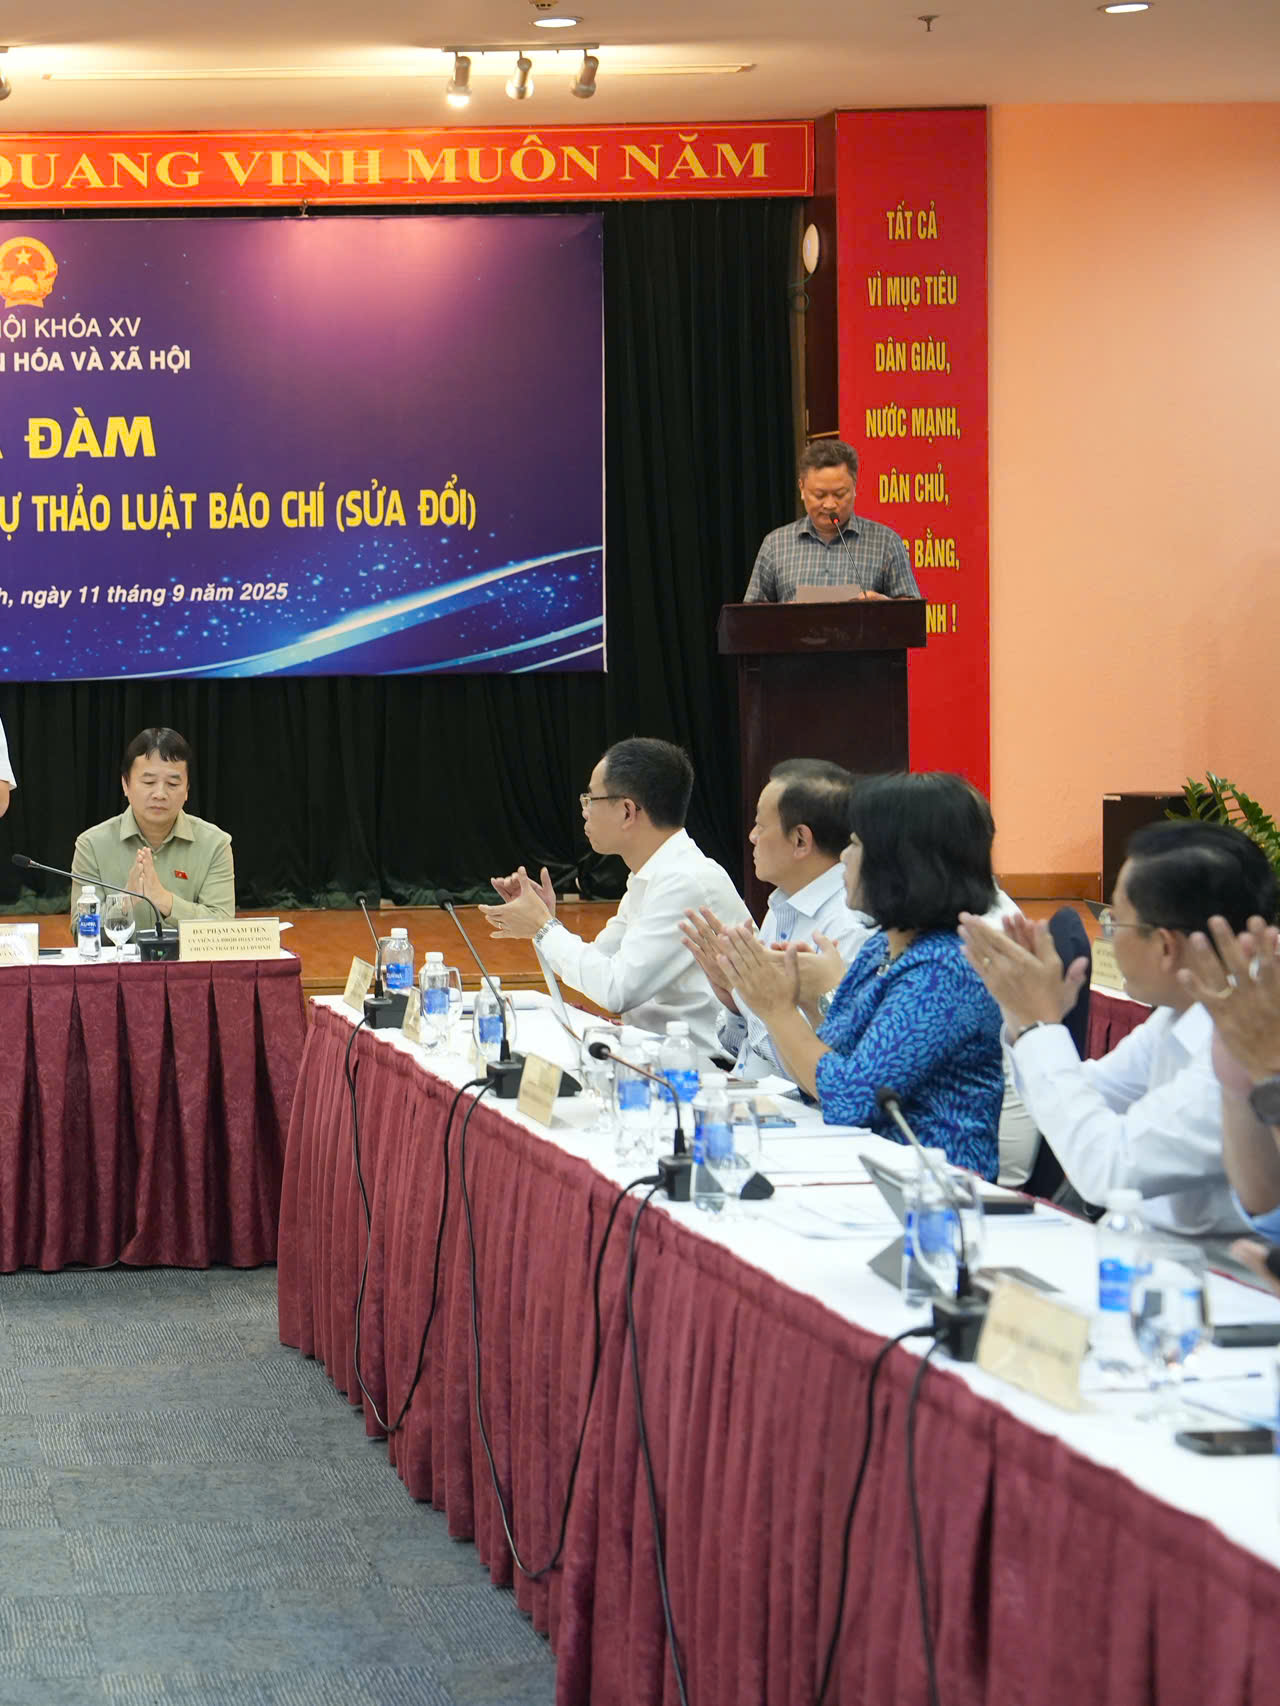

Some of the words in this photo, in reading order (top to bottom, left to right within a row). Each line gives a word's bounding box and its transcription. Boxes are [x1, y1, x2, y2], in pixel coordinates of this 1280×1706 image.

[219, 145, 381, 188] VINH
[401, 133, 603, 186] MUÔN
[619, 131, 772, 180] NĂM
[887, 200, 913, 240] TẤT
[917, 201, 937, 240] CẢ
[868, 273, 882, 305] VÌ
[887, 276, 921, 312] MỤC
[925, 270, 957, 305] TIÊU
[34, 312, 102, 338] KHÓA
[108, 317, 141, 337] XV
[13, 346, 65, 372] HÓA
[70, 345, 104, 371] VÀ
[110, 345, 143, 371] XÃ
[150, 344, 191, 374] HỘI
[875, 336, 907, 372] DÂN
[911, 335, 951, 373] GIÀU,
[23, 406, 156, 459] ĐÀM
[865, 405, 907, 438] NƯỚC
[911, 407, 961, 442] MẠNH,
[879, 469, 910, 504] DÂN
[914, 463, 949, 505] CHỦ,
[31, 483, 111, 532] THẢO
[121, 485, 197, 539] LUẬT
[209, 483, 270, 530] BÁO
[281, 481, 325, 528] CHÍ
[335, 478, 407, 533] (SỬA
[417, 473, 476, 531] ĐỔI)
[914, 527, 960, 569] BẰNG,
[20, 585, 73, 609] ngày
[79, 585, 100, 604] 11
[107, 584, 167, 607] tháng
[172, 584, 185, 602] 9
[189, 583, 234, 602] năm
[239, 582, 289, 601] 2025
[925, 603, 947, 633] NH
